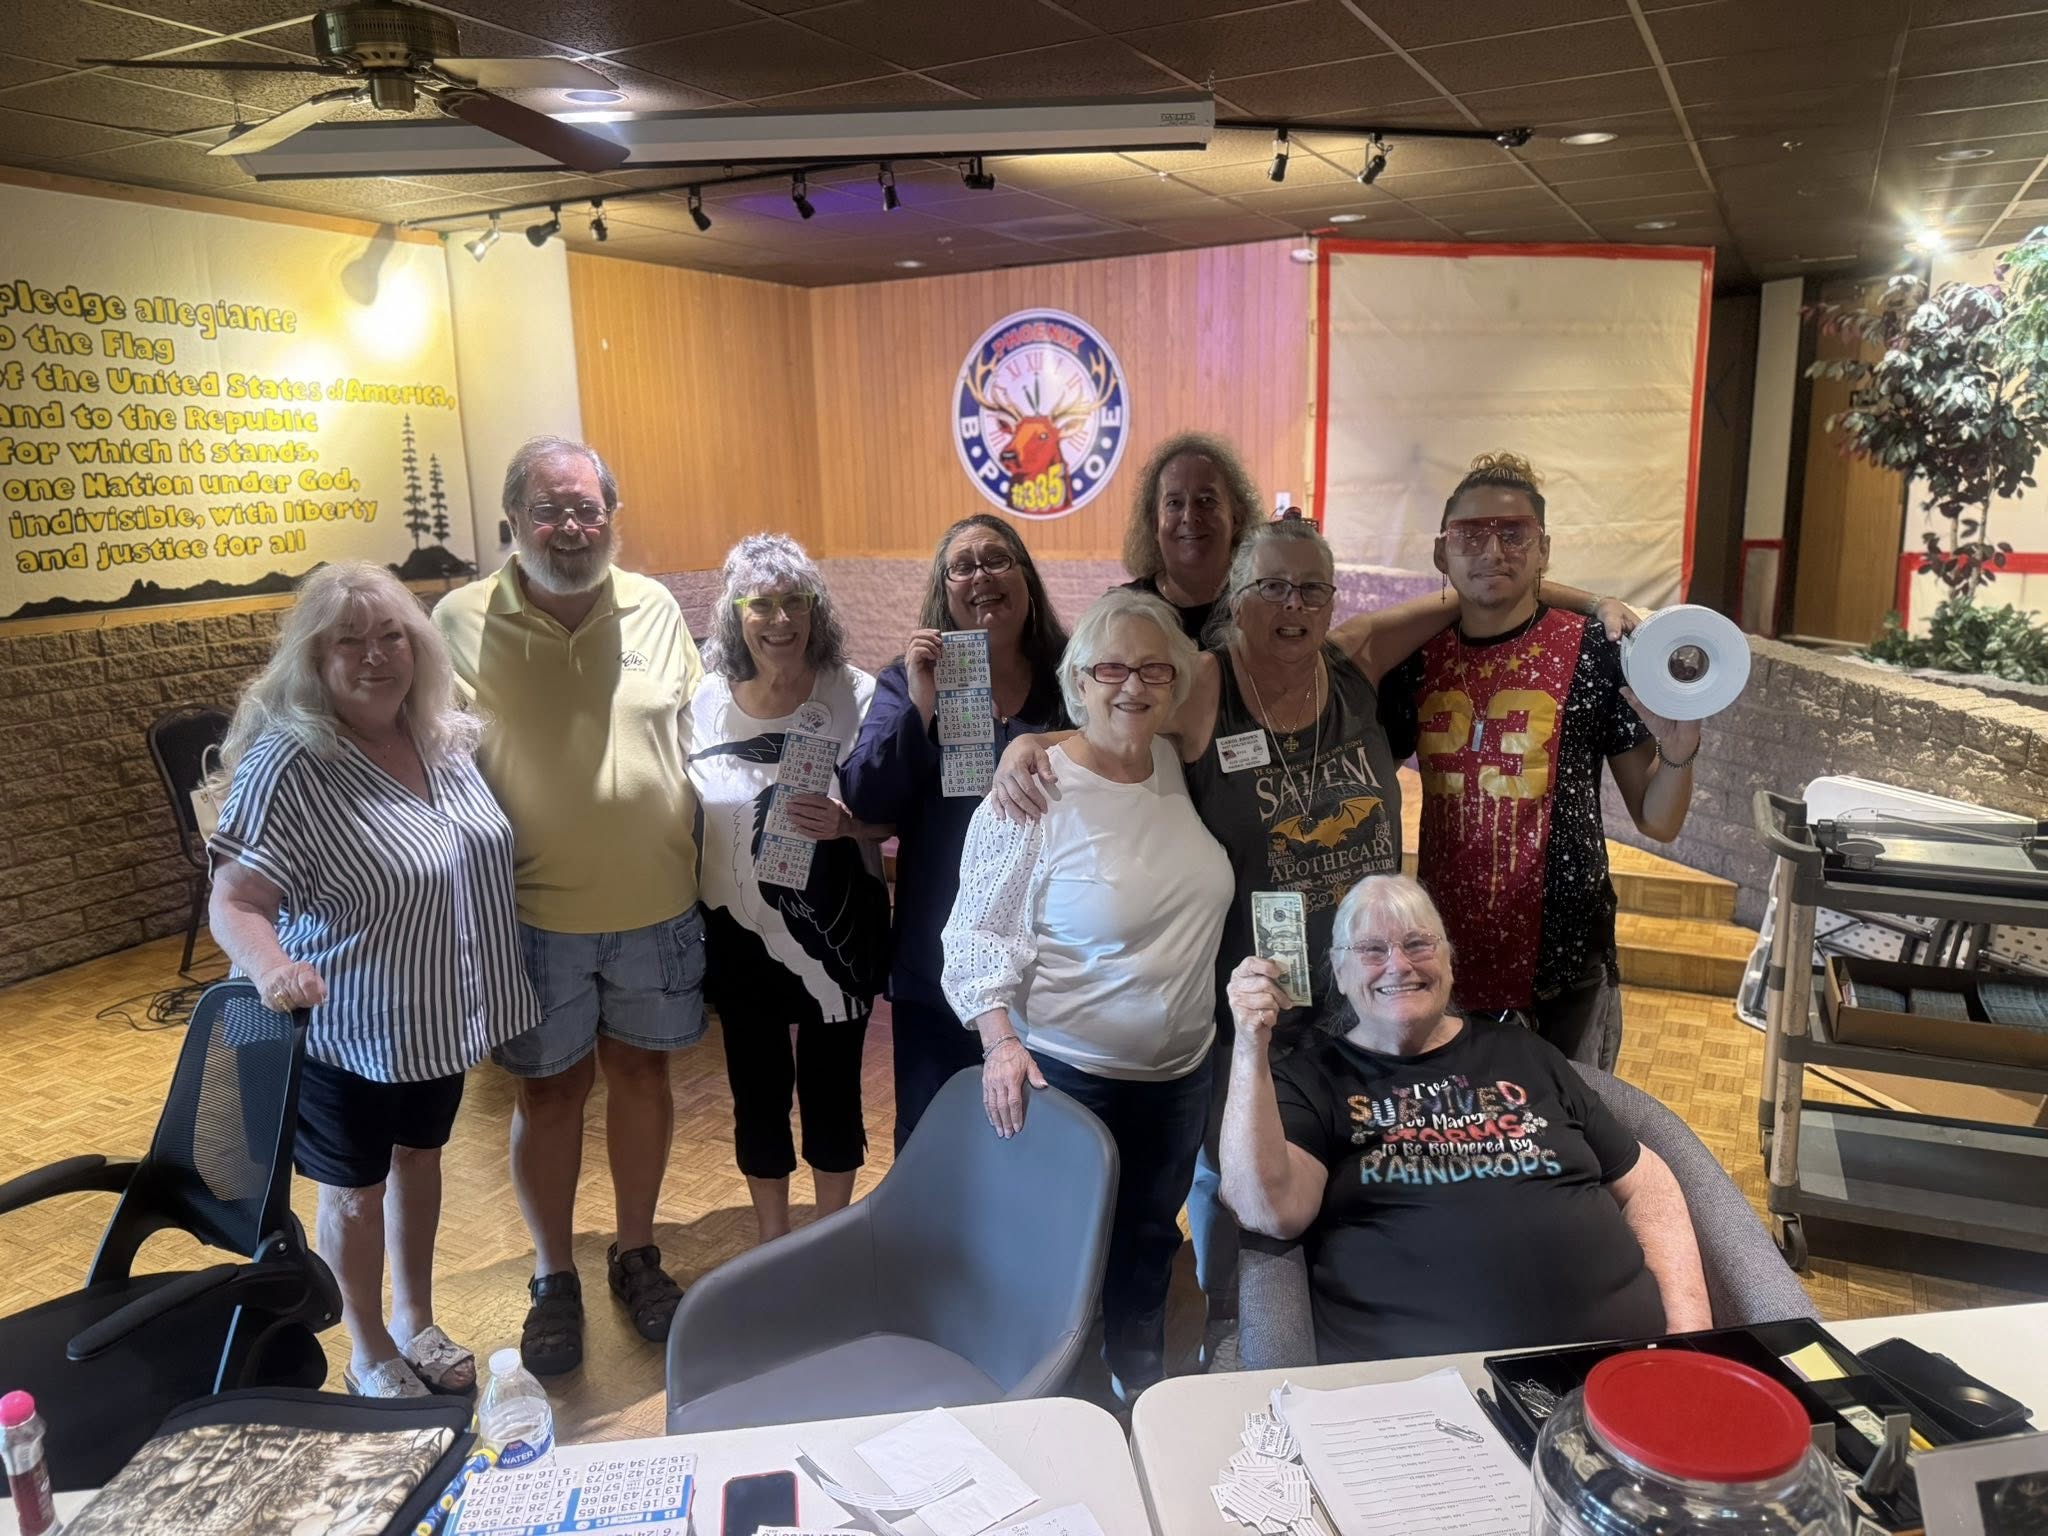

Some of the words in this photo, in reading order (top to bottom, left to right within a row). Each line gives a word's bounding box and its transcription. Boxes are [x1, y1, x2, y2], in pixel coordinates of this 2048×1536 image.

[0, 280, 126, 324] pledge
[135, 296, 297, 340] allegiance
[0, 325, 16, 351] o
[22, 323, 93, 356] the
[101, 330, 175, 365] Flag
[991, 322, 1085, 358] PHOENIX
[0, 361, 24, 390] f
[32, 362, 100, 393] the
[106, 367, 220, 397] United
[226, 372, 322, 401] States
[327, 378, 344, 401] of
[345, 379, 456, 410] America,
[71, 403, 112, 430] to
[118, 404, 177, 431] the
[184, 405, 318, 434] Republic
[1101, 406, 1121, 427] E
[960, 416, 981, 439] B
[0, 437, 60, 465] for
[67, 438, 172, 464] which
[179, 438, 206, 464] it
[211, 439, 319, 463] stands,
[1084, 454, 1106, 479] O
[978, 462, 1000, 481] P
[3, 478, 75, 501] one
[82, 472, 193, 499] Nation
[200, 471, 292, 494] under
[298, 467, 361, 492] God,
[1011, 463, 1066, 510] #335
[9, 504, 206, 539] indivisible,
[209, 501, 278, 527] with
[283, 499, 378, 523] liberty
[16, 542, 88, 573] and
[97, 537, 208, 571] justice
[214, 533, 262, 557] for
[269, 529, 306, 555] all
[1417, 689, 1558, 800] 23
[1256, 747, 1383, 822] SALEM
[1270, 838, 1393, 883] APOTHECARY
[1347, 1080, 1528, 1127] SURVIVED
[1432, 1112, 1484, 1130] Many
[1382, 1113, 1526, 1143] STORMS
[1429, 1139, 1504, 1156] Bothered
[1510, 1138, 1534, 1152] By
[1360, 1149, 1562, 1185] RAINDROPS
[1267, 1428, 1276, 1447] TICKET
[501, 1450, 534, 1465] WATER
[589, 1464, 604, 1472] 70
[609, 1462, 625, 1470] 49
[628, 1470, 644, 1478] 42
[650, 1467, 665, 1475] 21
[477, 1476, 490, 1484] 71
[586, 1475, 602, 1483] 73
[607, 1472, 622, 1480] 50
[667, 1475, 682, 1483] 12
[535, 1481, 551, 1489] 30
[558, 1478, 570, 1487] 11
[646, 1477, 663, 1485] 20
[472, 1487, 488, 1495] 74
[492, 1485, 508, 1494] 60
[584, 1486, 600, 1494] 68
[605, 1483, 621, 1492] 57
[645, 1488, 660, 1496] 17
[665, 1486, 681, 1494] 13
[532, 1492, 548, 1500] 29
[602, 1493, 618, 1502] 58
[624, 1491, 640, 1499] 43
[467, 1498, 484, 1506] 72
[490, 1496, 505, 1504] 51
[582, 1497, 597, 1505] 66
[643, 1500, 658, 1508] 16
[668, 1497, 676, 1505] 6
[529, 1503, 545, 1512] 28
[554, 1501, 562, 1509] 7
[621, 1502, 637, 1511] 33
[463, 1510, 480, 1519] 62
[484, 1507, 501, 1516] 59
[507, 1506, 523, 1514] 42
[579, 1508, 595, 1517] 65
[600, 1506, 616, 1514] 48
[526, 1514, 541, 1523] 27
[547, 1512, 561, 1520] 12
[459, 1521, 476, 1530] 63
[481, 1519, 498, 1528] 55
[503, 1517, 519, 1525] 37
